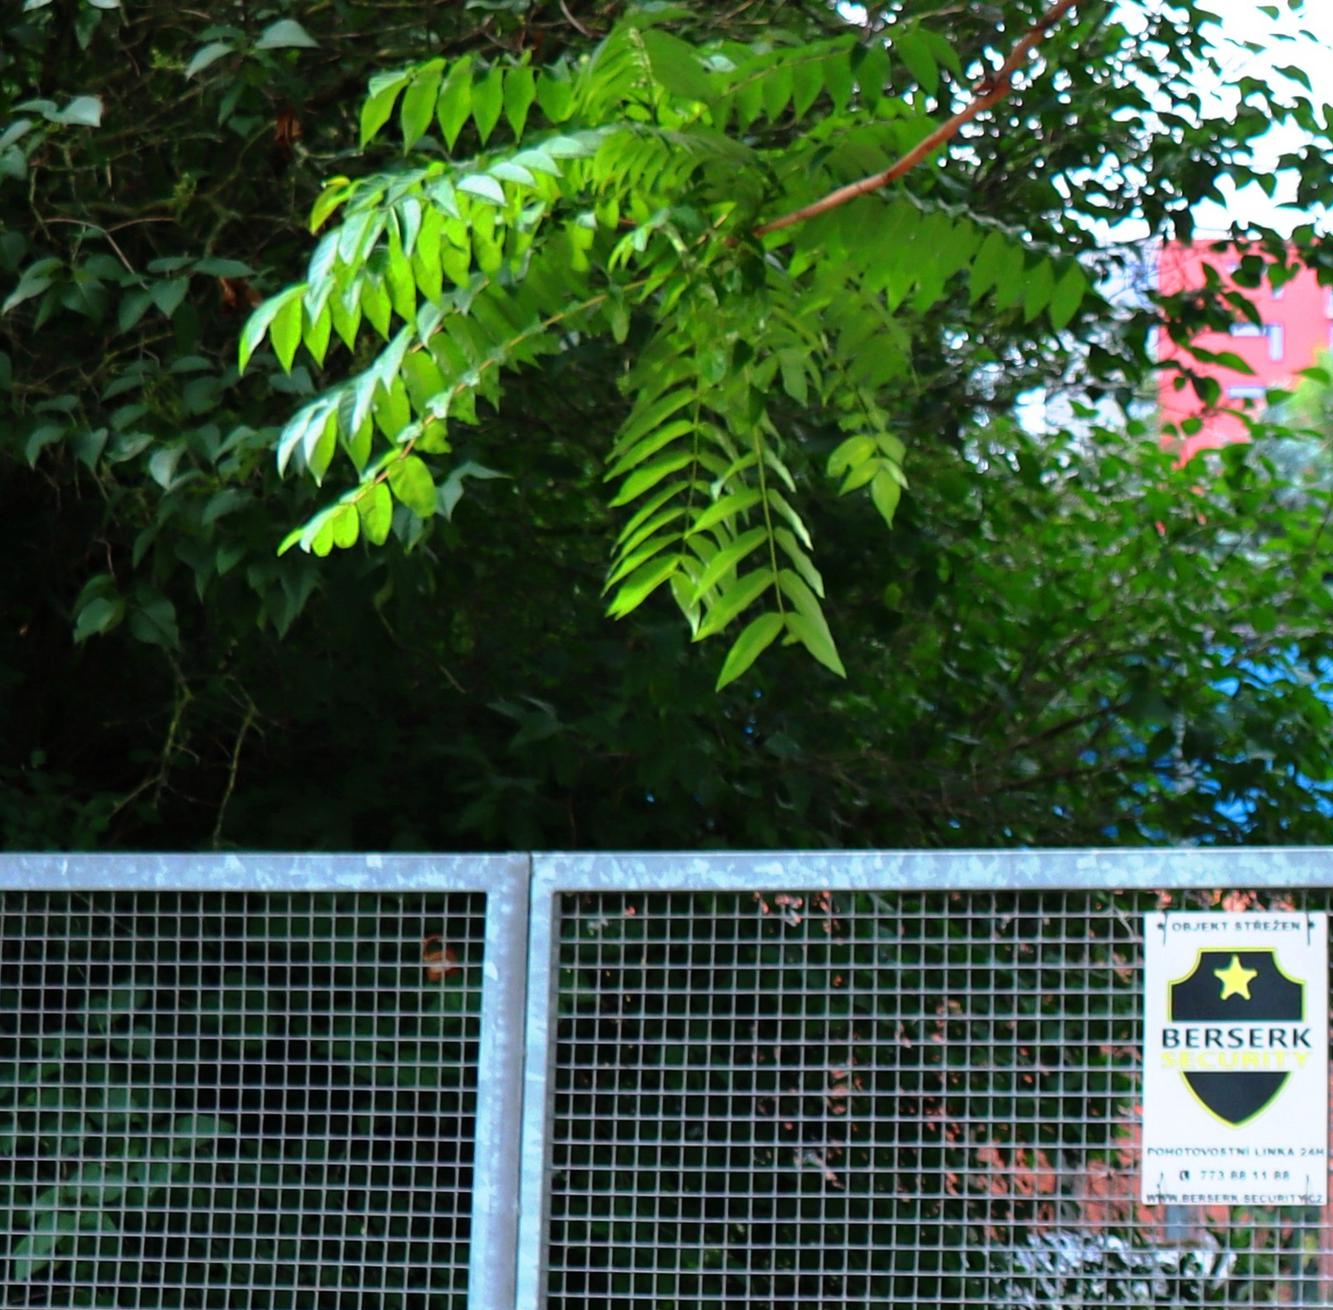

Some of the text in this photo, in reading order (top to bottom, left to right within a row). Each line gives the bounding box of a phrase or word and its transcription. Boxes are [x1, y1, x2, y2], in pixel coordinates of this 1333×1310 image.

[1171, 919, 1301, 932] OBJEKT STŘEŽEN
[1162, 1028, 1312, 1048] BERSERK
[1160, 1050, 1310, 1070] SECURITY
[1147, 1145, 1249, 1156] POHOTOVOSTNÍ
[1255, 1146, 1294, 1156] LINKA
[1200, 1170, 1225, 1181] 773
